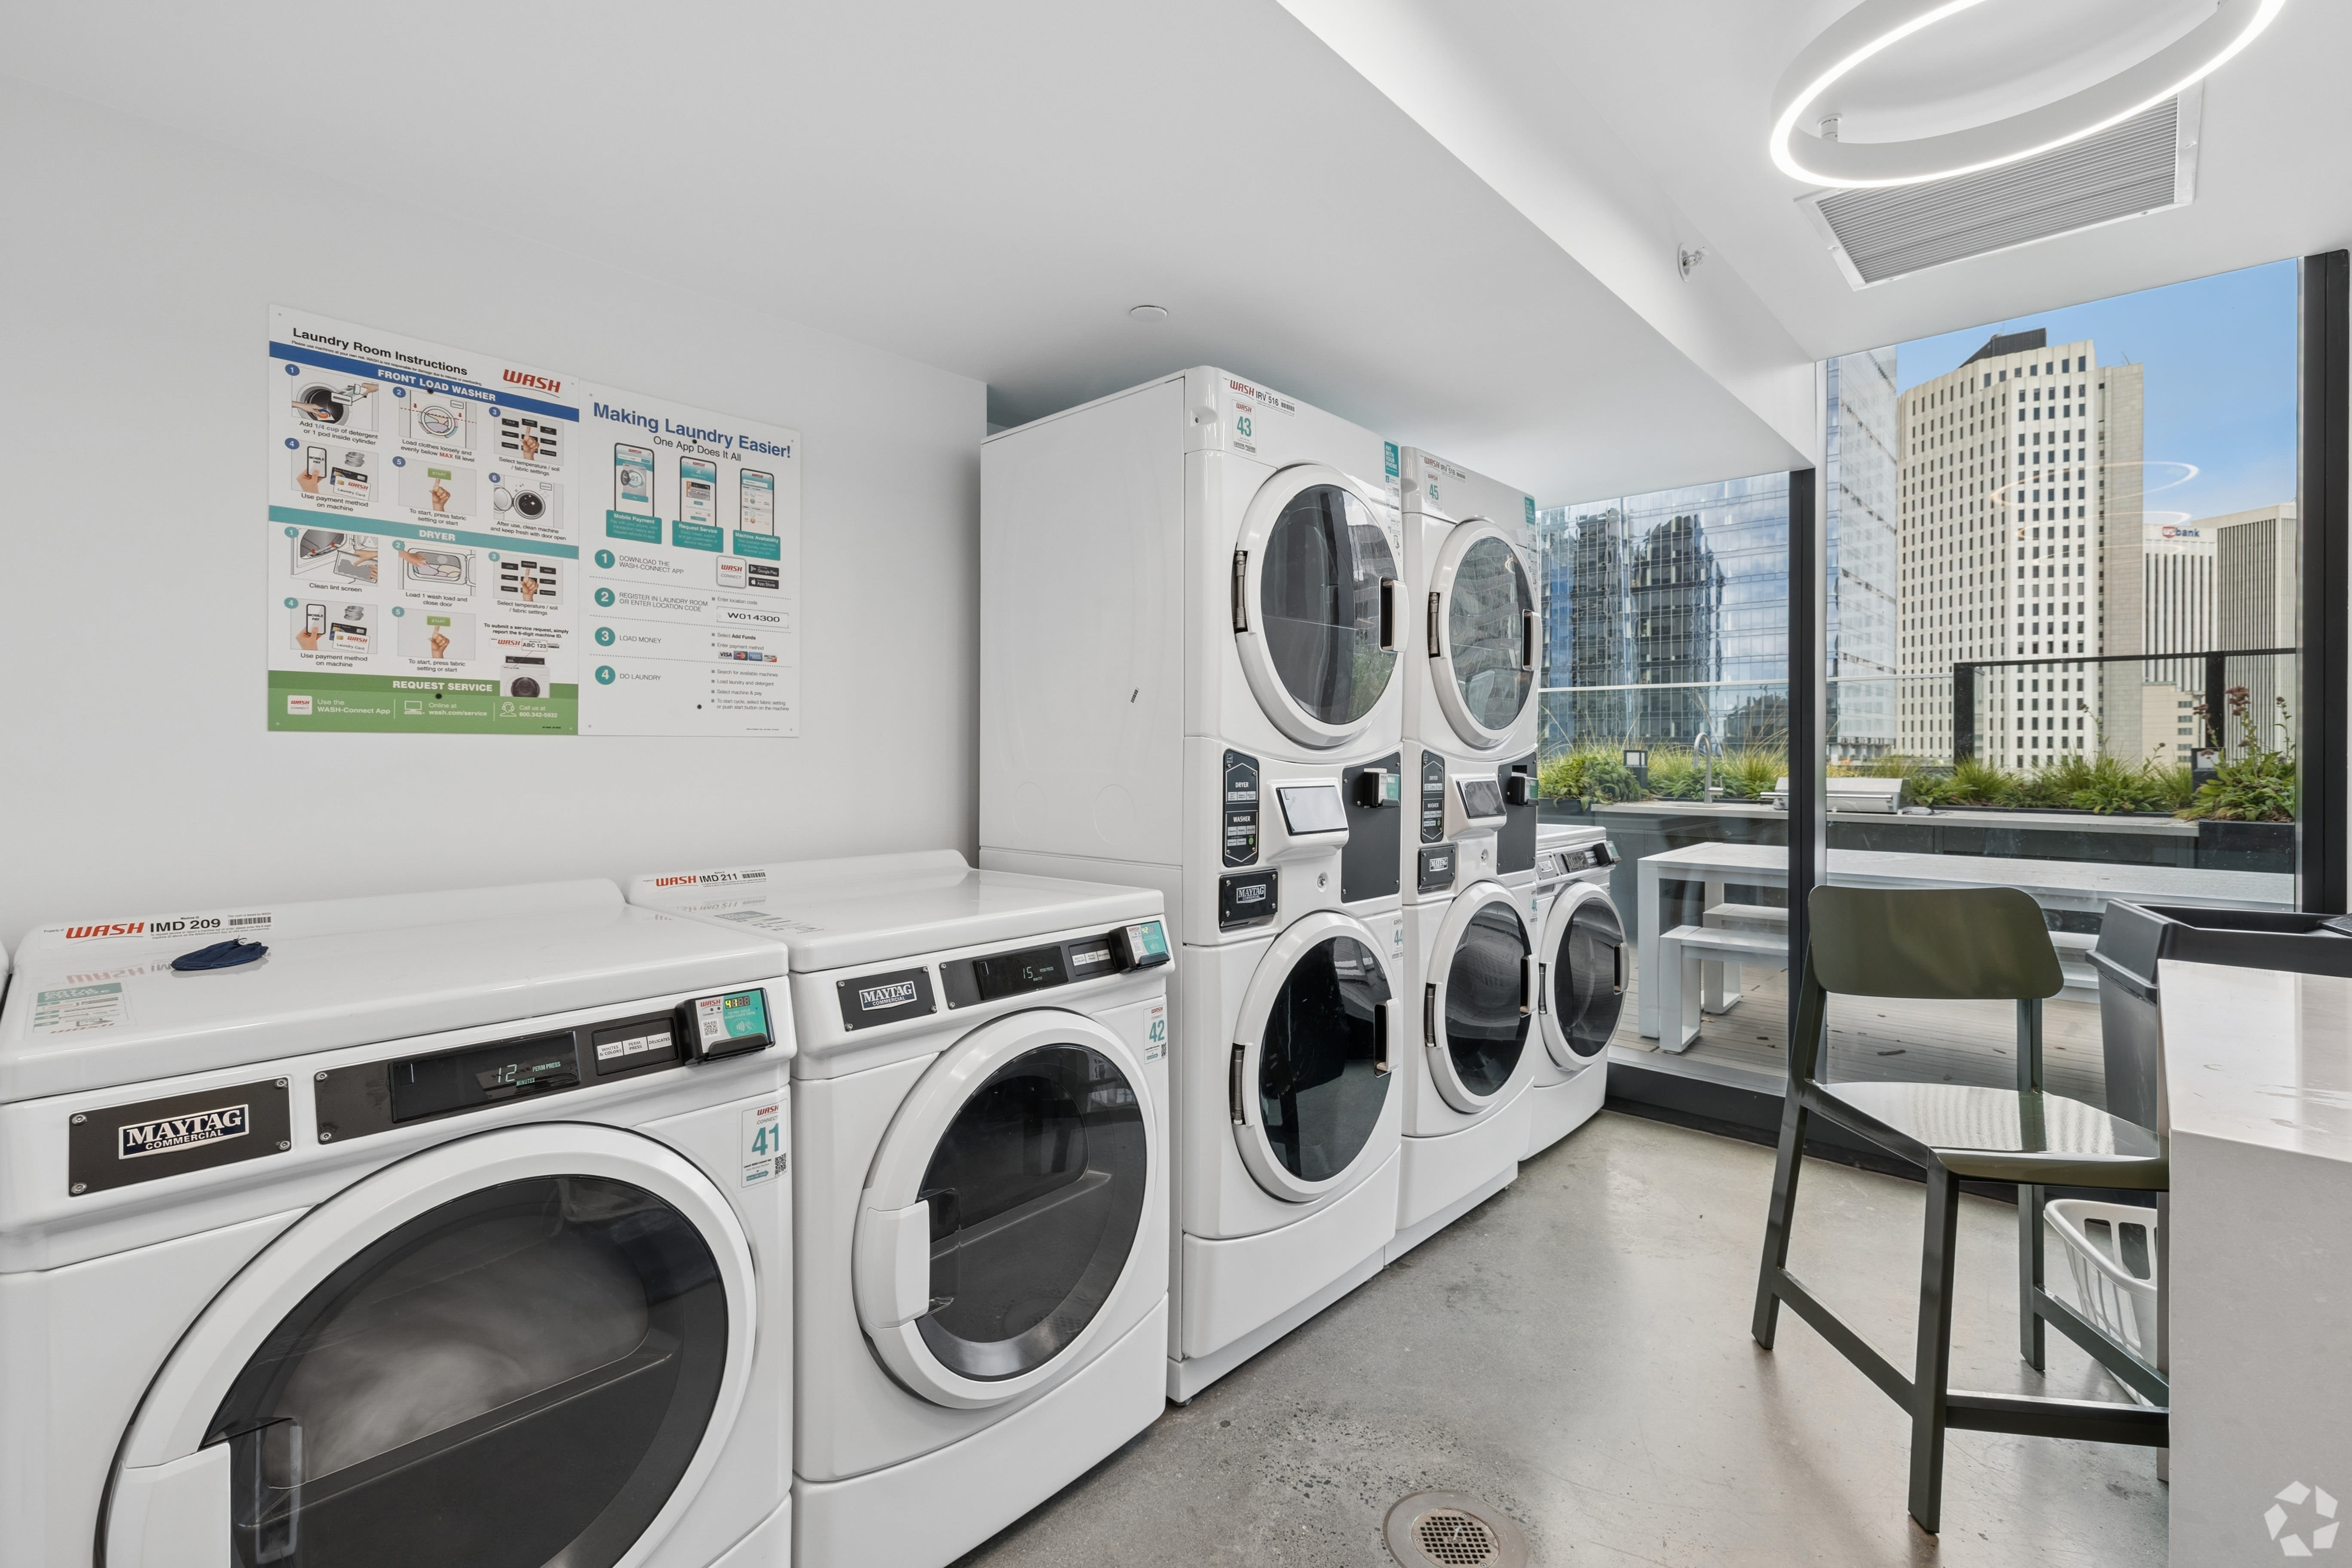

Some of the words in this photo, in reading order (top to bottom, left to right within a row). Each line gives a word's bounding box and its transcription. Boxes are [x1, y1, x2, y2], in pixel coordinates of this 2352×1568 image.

[293, 328, 349, 349] Laundry
[354, 342, 391, 358] Room
[395, 352, 467, 375] Instructions
[378, 369, 416, 383] FRONT
[420, 378, 449, 390] LOAD
[452, 386, 496, 401] WASHER
[502, 369, 561, 393] WASH
[1230, 380, 1254, 396] WASH
[1256, 391, 1266, 401] IRV
[1268, 396, 1279, 406] 516
[1236, 402, 1252, 413] WASH
[594, 403, 658, 432] Making
[665, 419, 733, 448] Laundry
[739, 435, 790, 458] Easier!
[1237, 416, 1252, 437] 43
[348, 430, 378, 438] detergent
[402, 439, 417, 448] Load
[440, 446, 460, 454] loosely
[653, 436, 673, 447] One
[676, 441, 696, 453] App
[697, 445, 720, 457] Does
[723, 450, 728, 459] It
[731, 453, 741, 461] All
[1386, 462, 1397, 470] PHONE
[1424, 456, 1439, 469] WASH
[1429, 484, 1439, 500] 45
[419, 530, 455, 541] DRYER
[602, 553, 606, 563] 1
[619, 555, 656, 565] DOWNLOAD
[619, 562, 670, 572] WASH-CONNECT
[721, 564, 742, 572] WASH
[601, 591, 609, 601] 2
[727, 612, 780, 622] W014300
[601, 631, 609, 641] 3
[497, 638, 521, 646] WASH
[601, 669, 609, 679] 4
[393, 681, 444, 689] REQUEST
[448, 683, 492, 691] SERVICE
[656, 875, 697, 887] WASH
[699, 874, 719, 883] IMD
[721, 873, 738, 882] 211
[1238, 886, 1265, 898] MAYTAG
[66, 922, 145, 939] WASH
[150, 921, 185, 932] IMD
[190, 919, 220, 929] 209
[1023, 966, 1033, 979] 15
[863, 983, 913, 1004] MAYTAG
[701, 999, 720, 1007] WASH
[872, 995, 905, 1006] COMMERCIAL
[1149, 1020, 1165, 1042] 42
[604, 1048, 622, 1057] COLORS
[546, 1062, 560, 1070] PRESS
[498, 1064, 517, 1083] 12
[516, 1077, 535, 1086] MINUTES
[757, 1105, 779, 1116] WASH
[757, 1115, 778, 1125] CONNECT
[126, 1109, 242, 1147] MAYTAG
[145, 1130, 224, 1150] COMMERCIAL
[752, 1123, 779, 1156] 41
